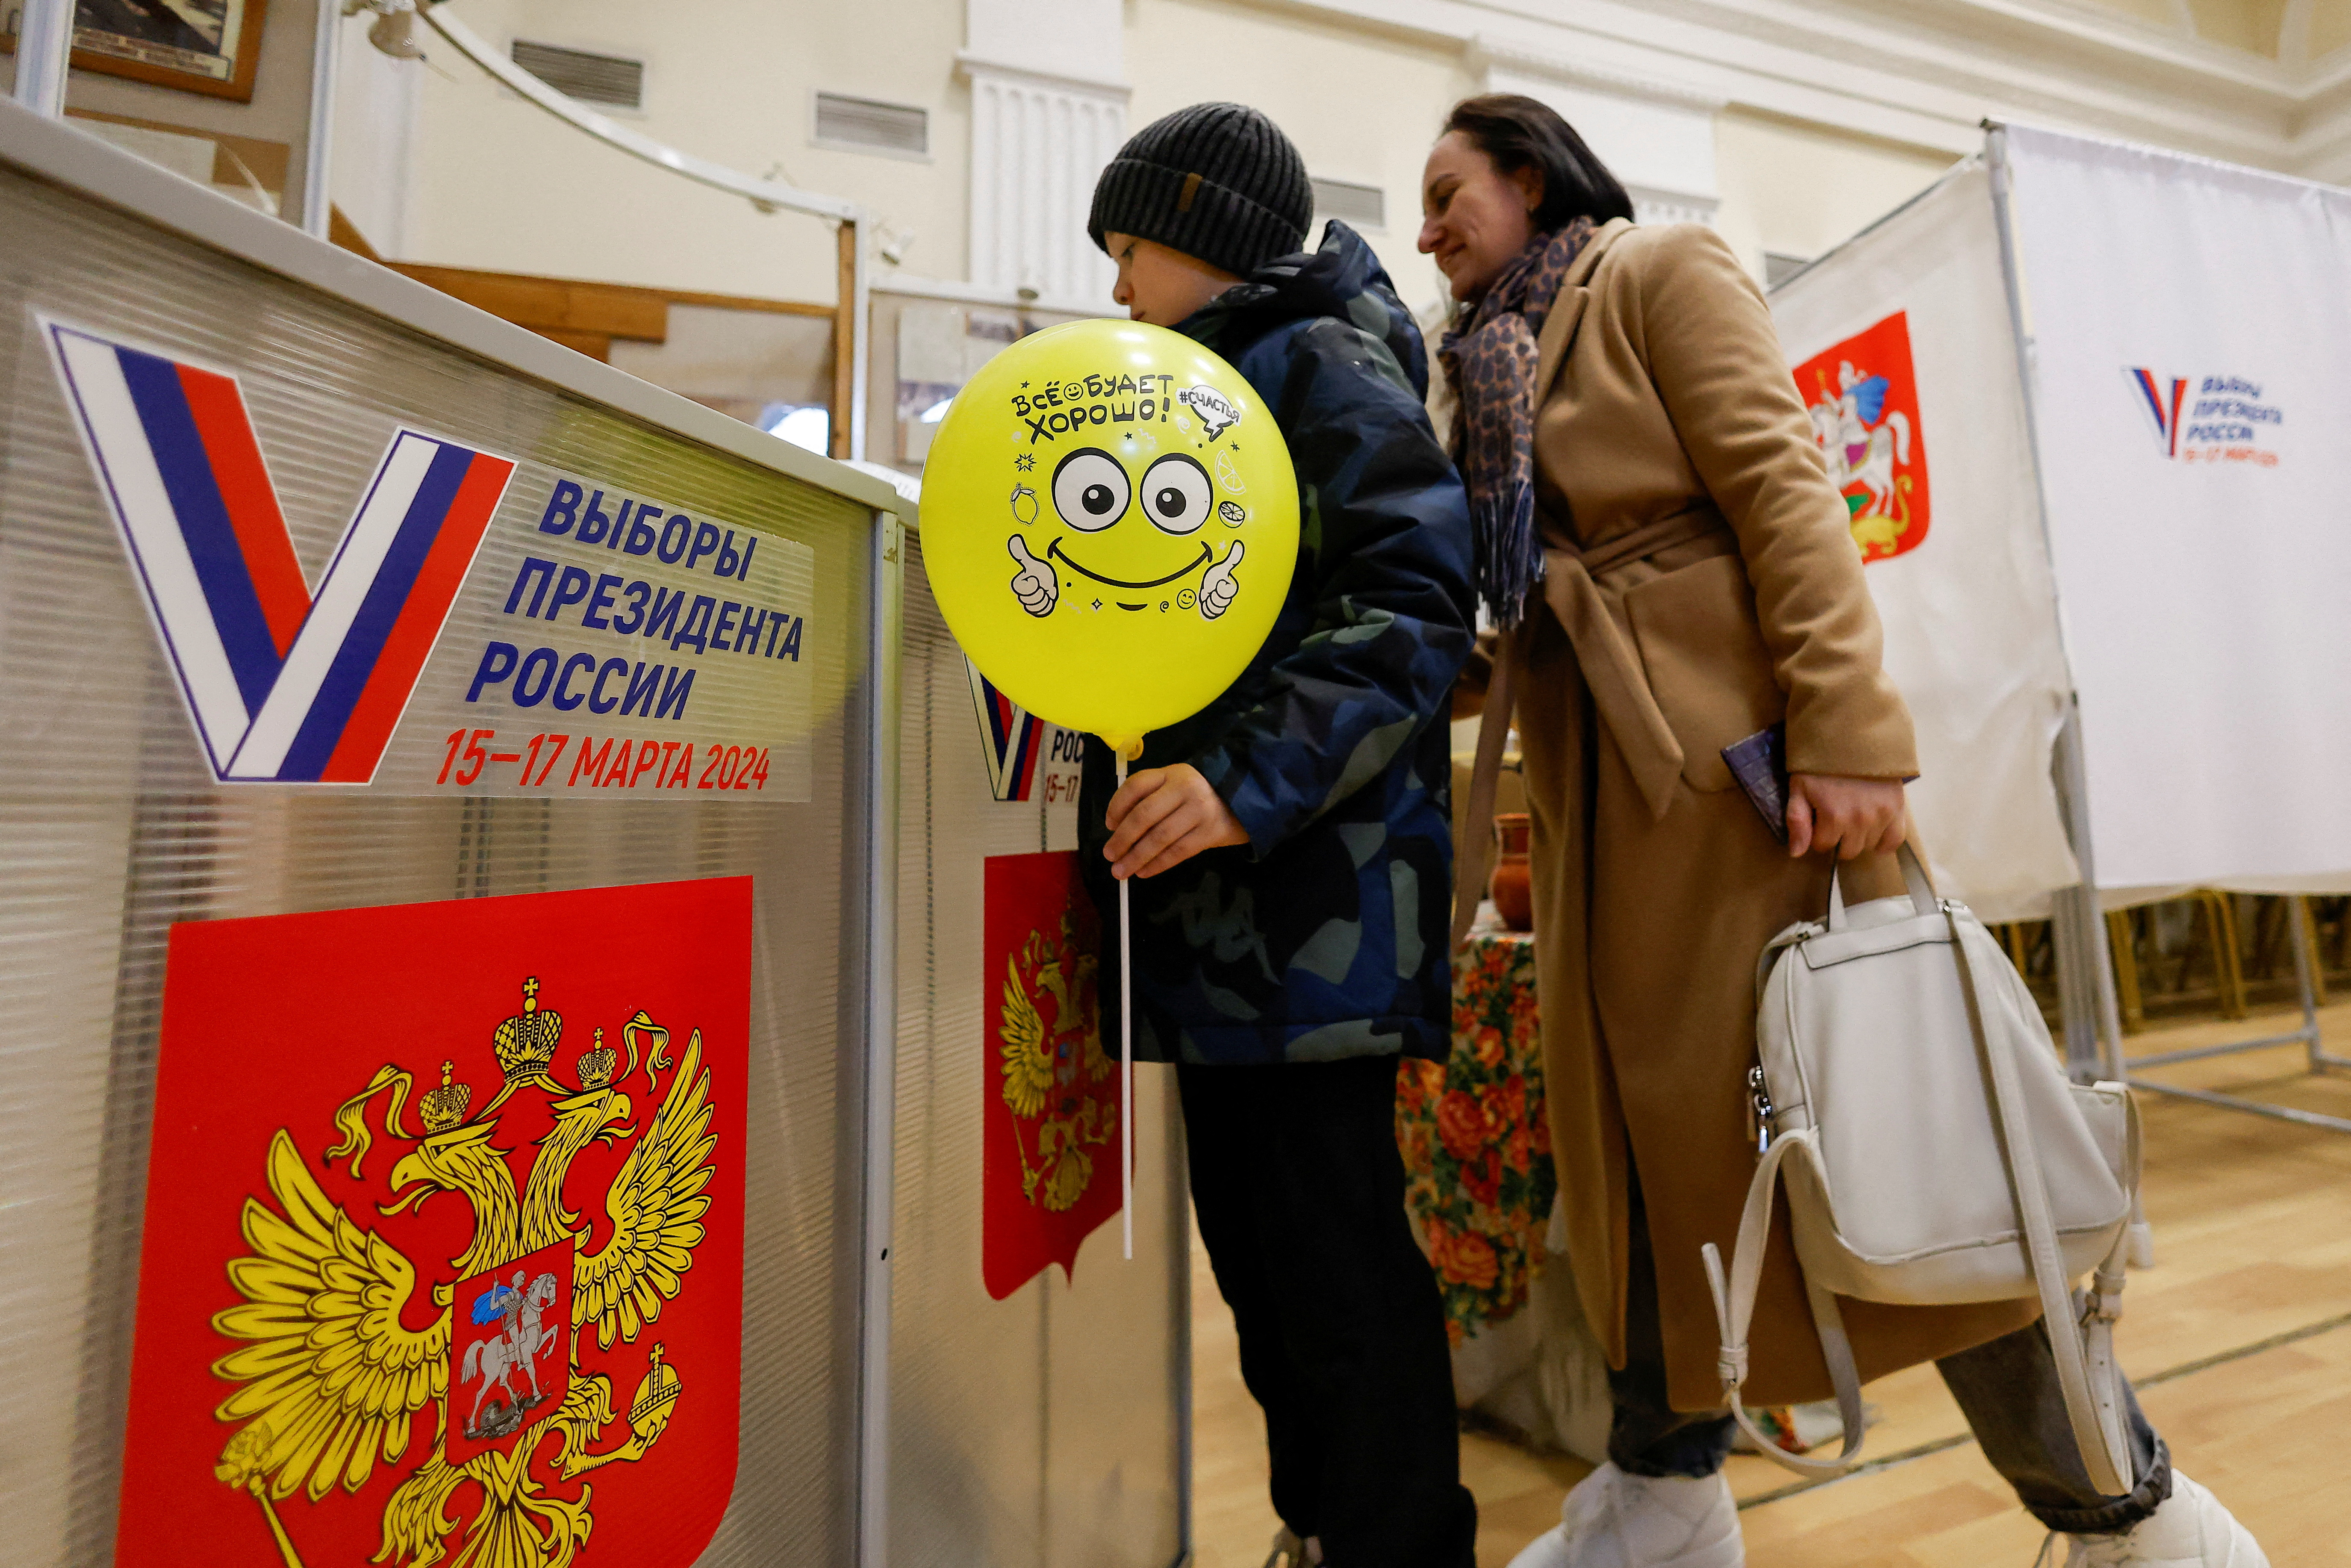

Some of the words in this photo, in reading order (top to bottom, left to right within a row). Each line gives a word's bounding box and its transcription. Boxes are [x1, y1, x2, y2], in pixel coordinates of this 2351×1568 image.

[1011, 380, 1063, 417] ВСЁ
[1083, 374, 1174, 398] БУДЕТ
[1025, 397, 1170, 445] ХОРОШО!
[1179, 391, 1240, 423] #СЧАСТЬЯ
[539, 479, 758, 581] ВЫБОРЫ
[504, 557, 804, 662] ПРЕЗИДЕНТА
[465, 641, 696, 720] РОССИИ
[567, 736, 693, 789] МАРТА
[697, 745, 769, 790] 2024
